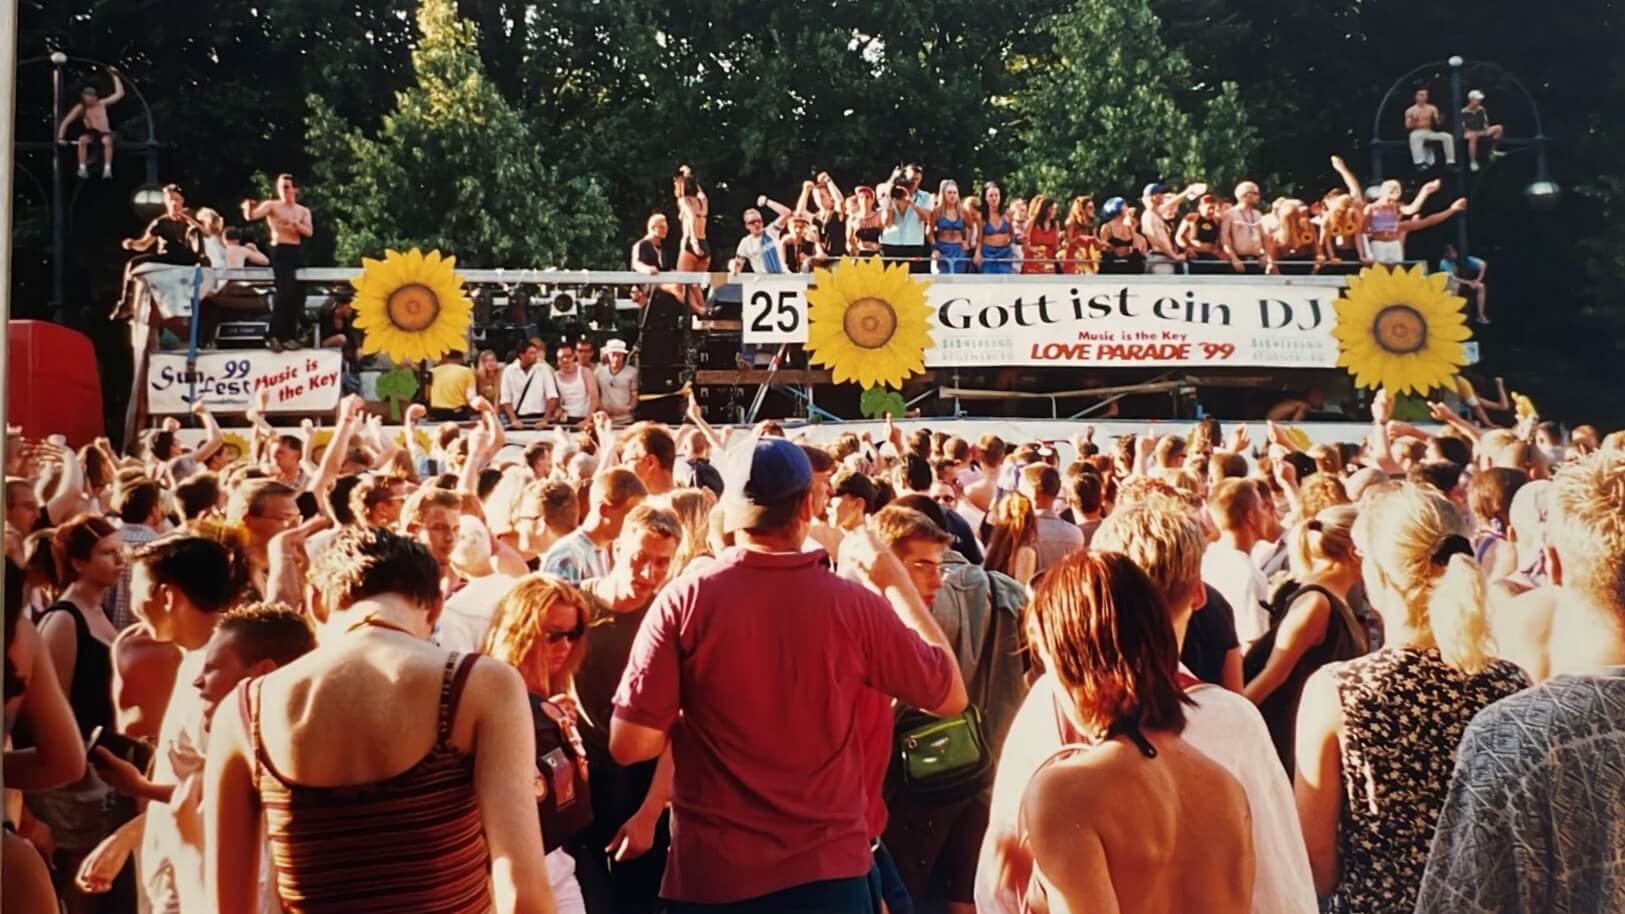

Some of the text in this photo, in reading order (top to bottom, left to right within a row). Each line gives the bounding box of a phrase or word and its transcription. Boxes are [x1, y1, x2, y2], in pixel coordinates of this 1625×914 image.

[751, 290, 799, 332] 25
[938, 286, 1322, 331] Gott ist ein DJ
[1030, 343, 1092, 360] LOVE
[1096, 343, 1192, 360] PARADE
[1077, 330, 1188, 342] Music is the Key
[220, 360, 251, 379] 99
[254, 358, 319, 392] Music is
[278, 370, 338, 402] the Key
